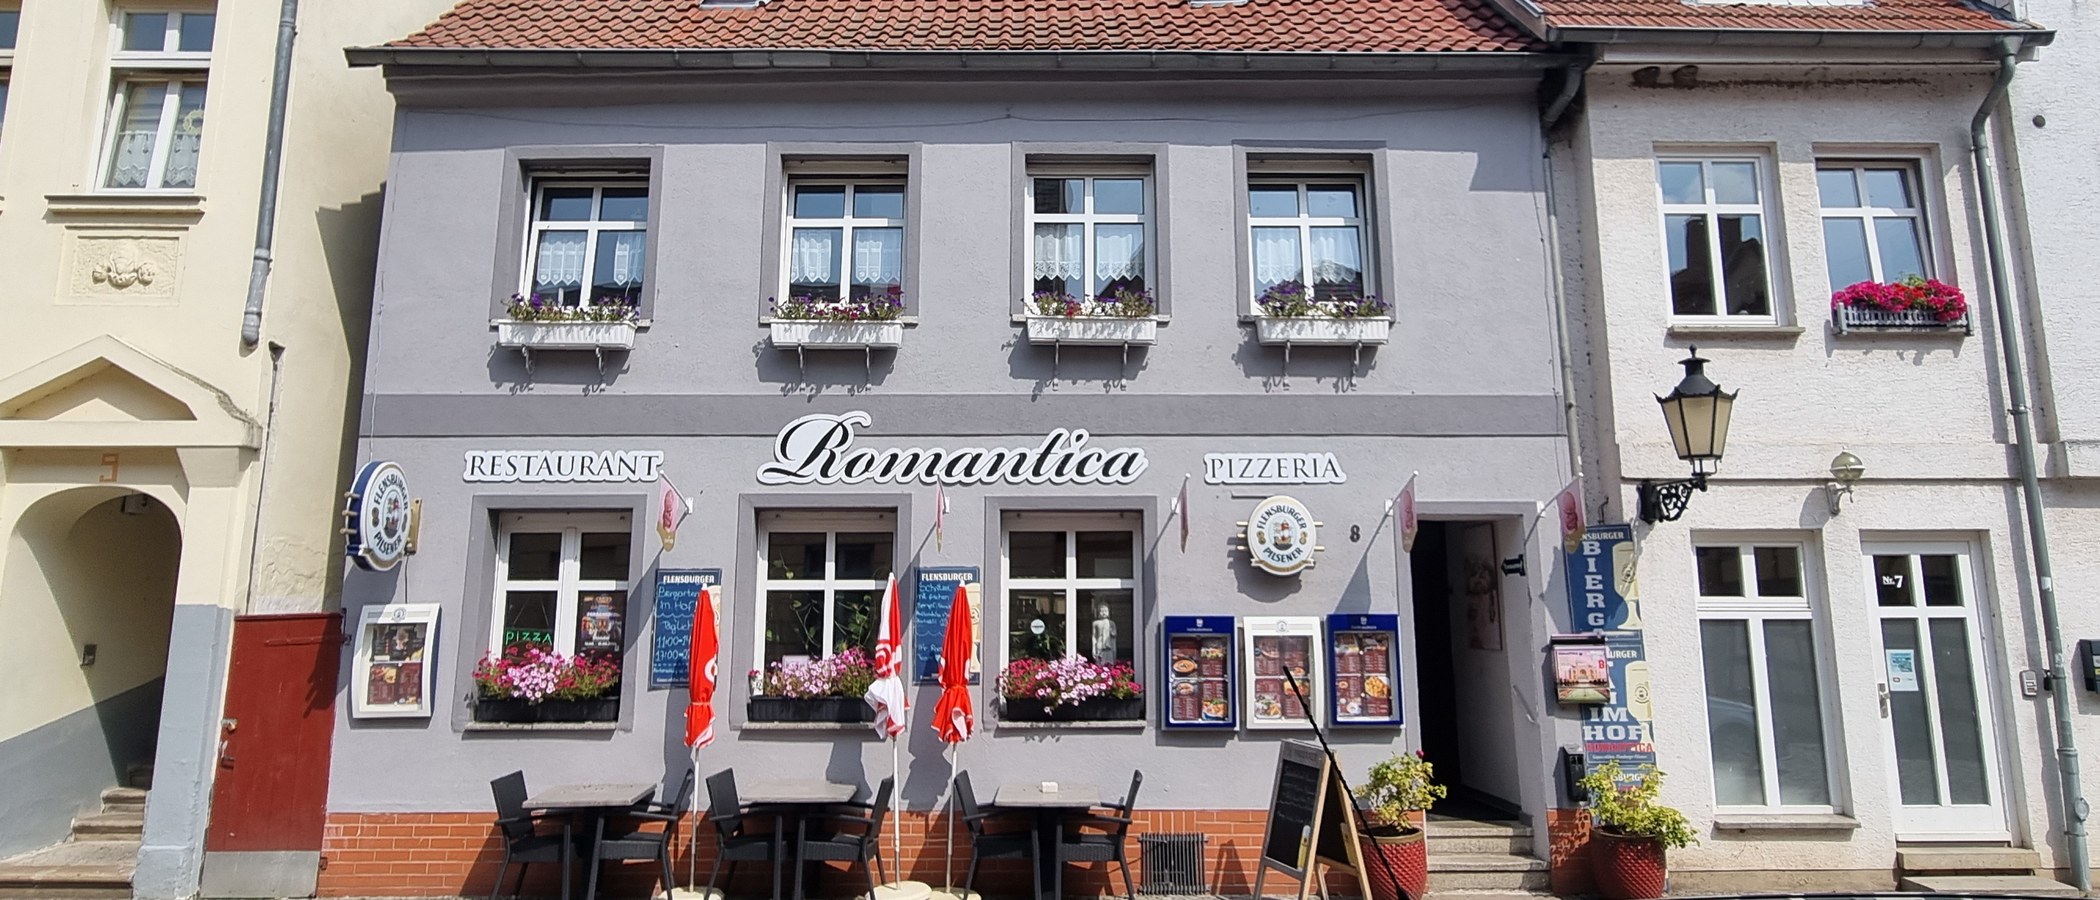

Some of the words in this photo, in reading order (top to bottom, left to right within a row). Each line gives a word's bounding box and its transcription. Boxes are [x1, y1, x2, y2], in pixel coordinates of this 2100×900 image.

[762, 415, 1144, 479] Romantica
[99, 453, 119, 482] 9
[470, 455, 659, 476] RESTAURANT
[1211, 458, 1340, 478] PIZZERIA
[1256, 505, 1307, 530] FLENSBURGER
[1350, 524, 1360, 542] 8
[373, 531, 402, 555] PILSENER
[1262, 546, 1303, 562] PILSENER
[663, 575, 715, 584] FLENSBURGER
[922, 573, 973, 581] FLENSBURGER
[1590, 707, 1629, 722] IM
[1583, 725, 1642, 740] HOF
